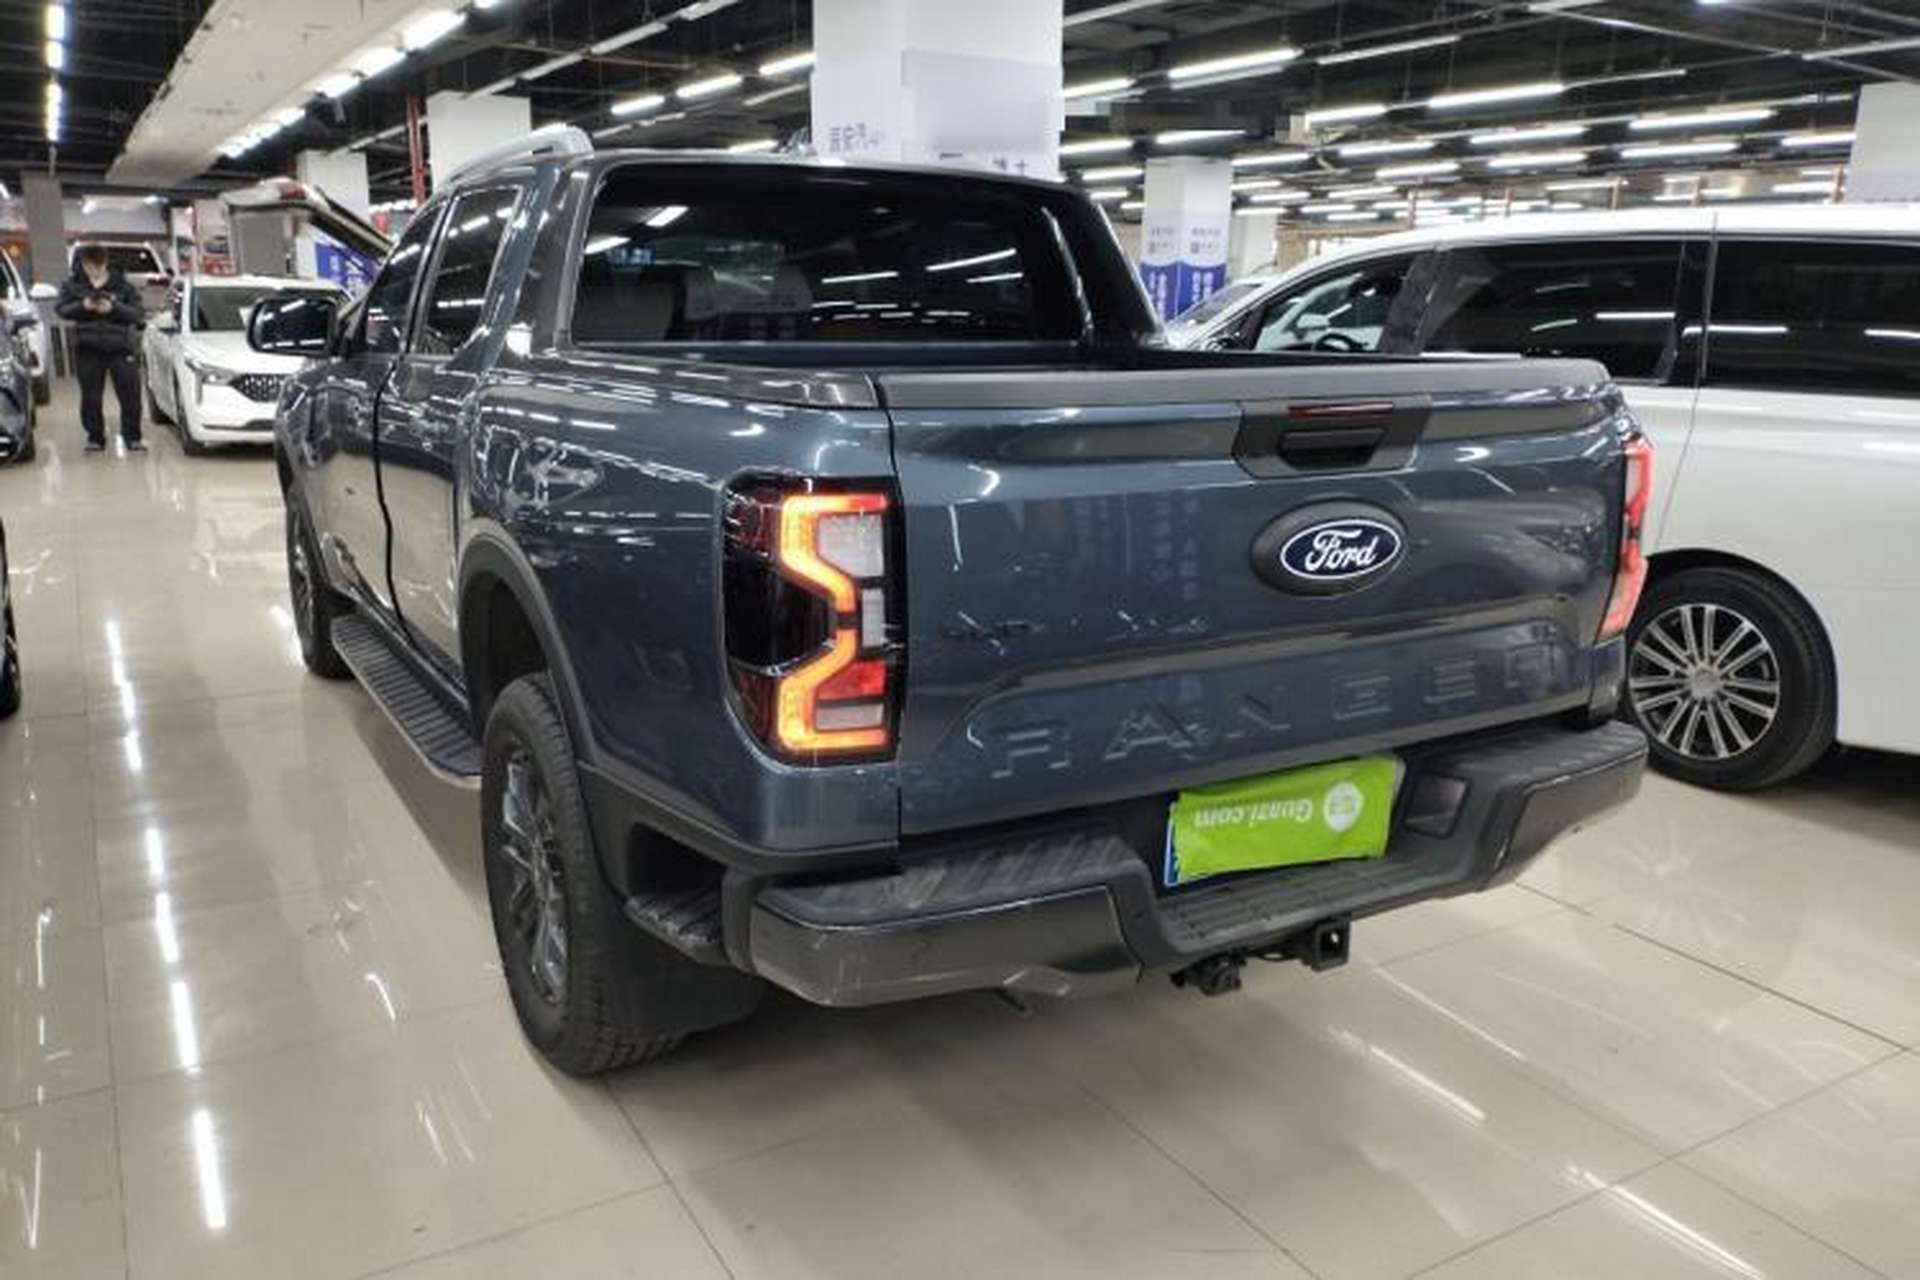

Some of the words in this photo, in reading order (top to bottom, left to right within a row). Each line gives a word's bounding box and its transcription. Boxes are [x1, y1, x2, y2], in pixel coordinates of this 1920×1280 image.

[1304, 529, 1379, 572] Ford
[990, 643, 1556, 778] RANGER
[1194, 798, 1313, 828] Guazi.com
